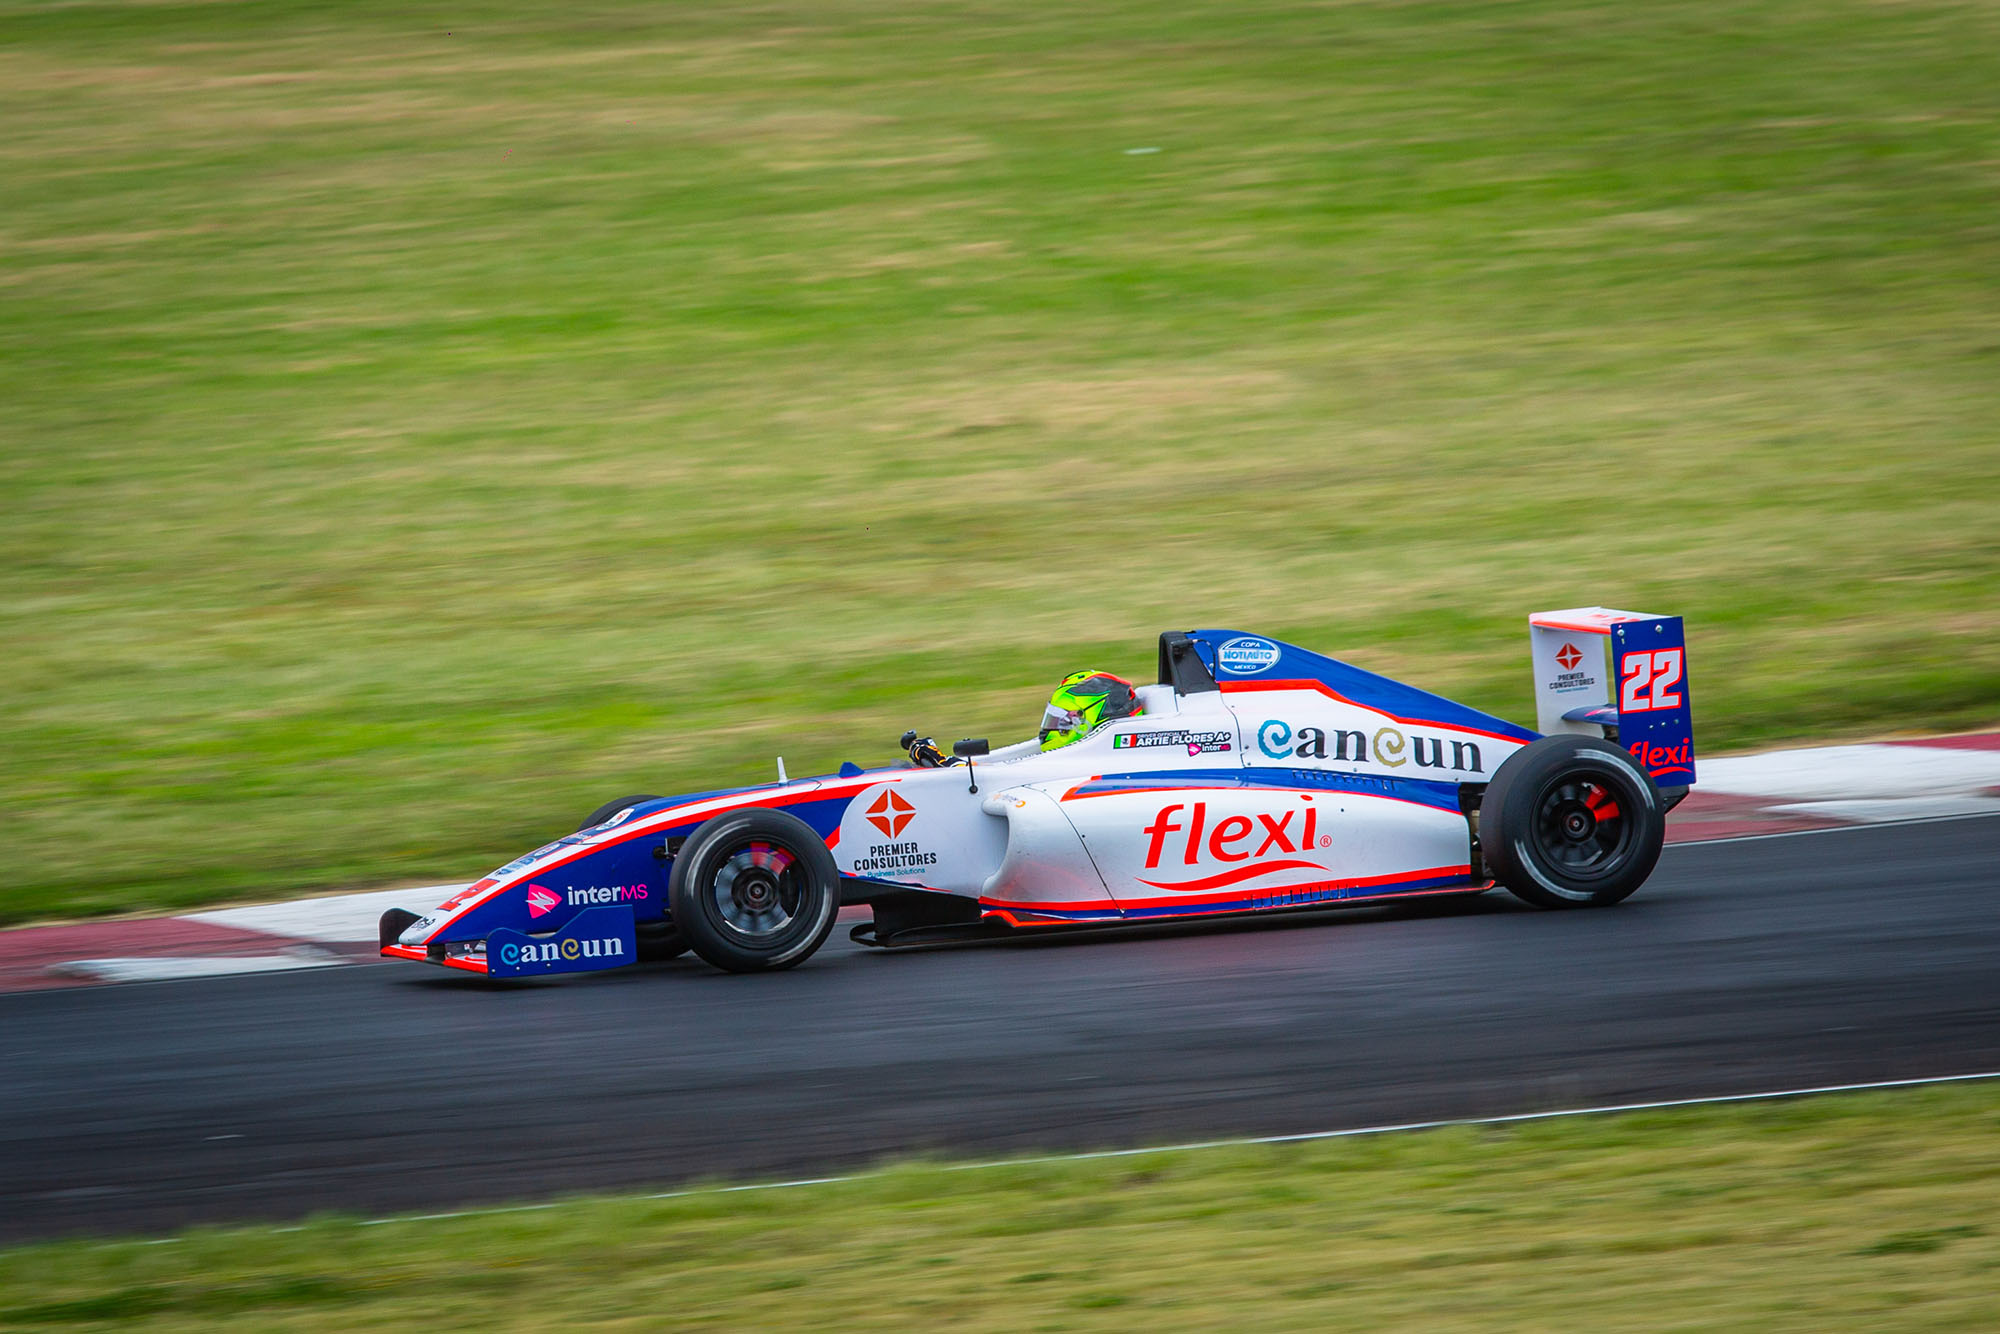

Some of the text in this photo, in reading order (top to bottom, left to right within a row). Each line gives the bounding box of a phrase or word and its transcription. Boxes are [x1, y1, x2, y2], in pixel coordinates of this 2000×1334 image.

[1549, 677, 1595, 690] CONSULTORES
[1557, 671, 1584, 681] PREMIER
[1619, 647, 1684, 715] 22
[1135, 736, 1170, 747] ARTIE
[1171, 732, 1214, 744] FLORES
[1629, 737, 1690, 767] flexi
[869, 842, 919, 858] PREMIER
[853, 852, 938, 872] CONSULTORES
[867, 867, 926, 878] Business Solutions
[567, 883, 649, 906] interMS
